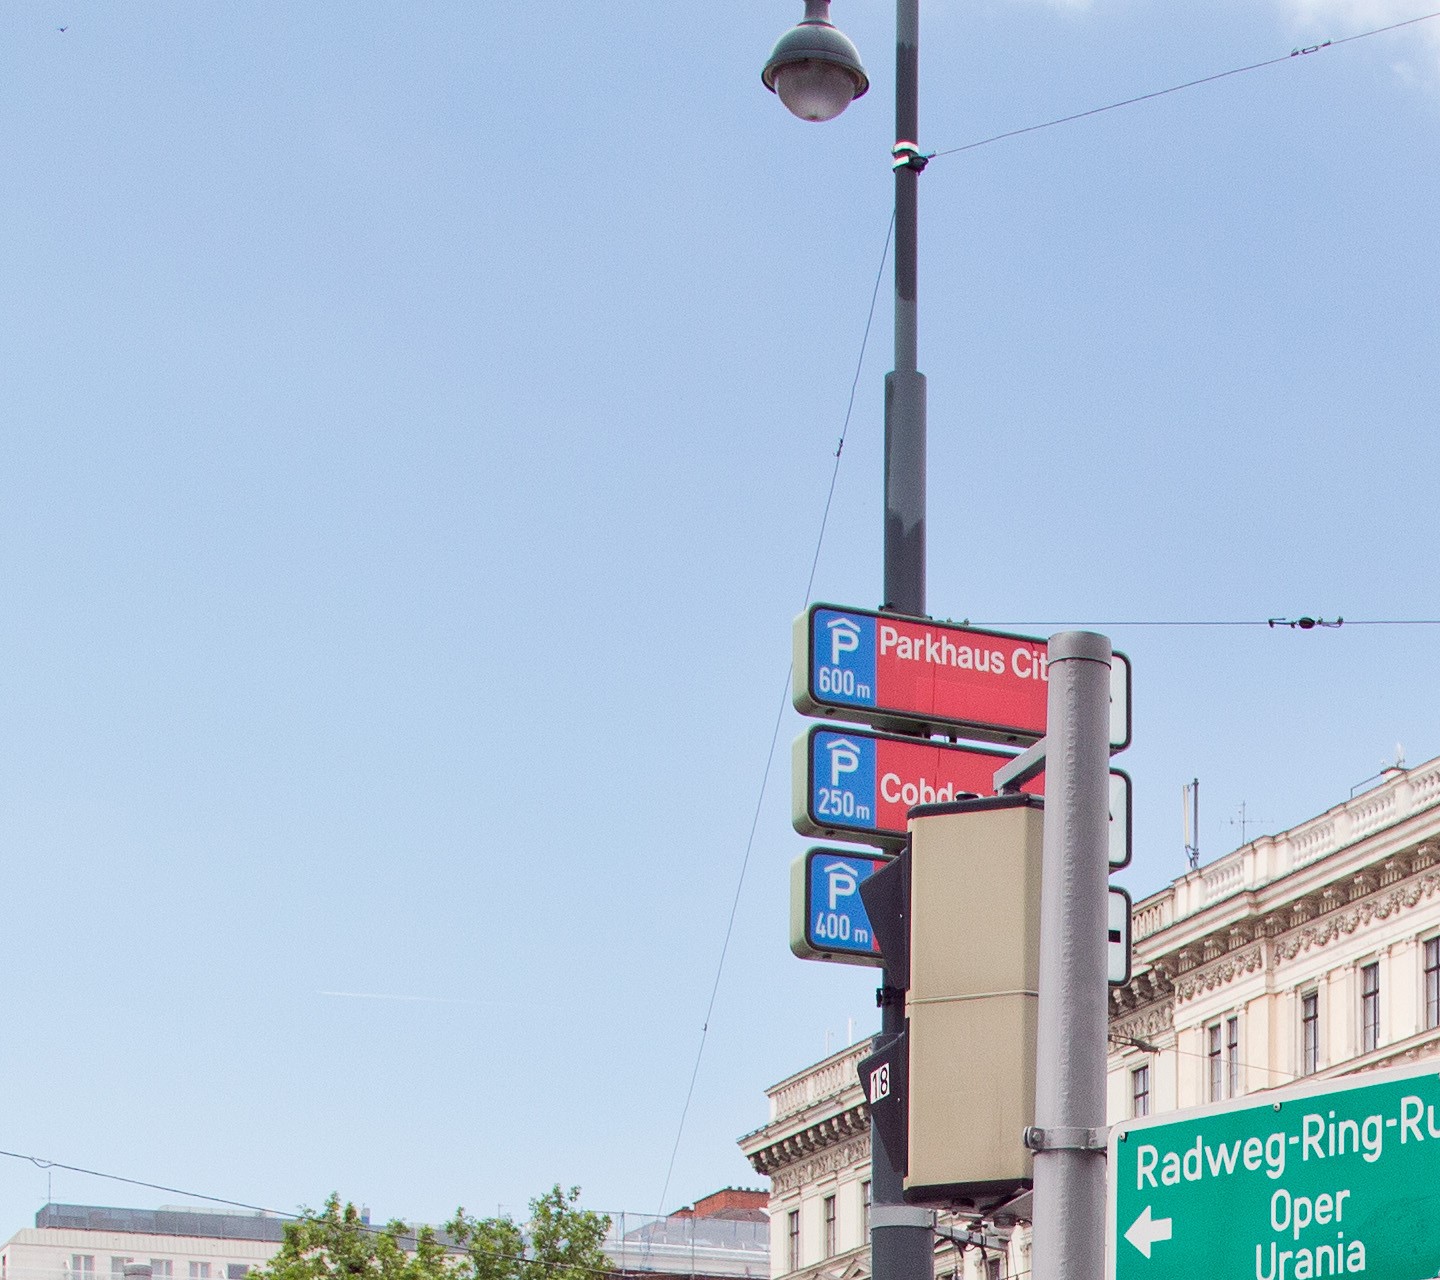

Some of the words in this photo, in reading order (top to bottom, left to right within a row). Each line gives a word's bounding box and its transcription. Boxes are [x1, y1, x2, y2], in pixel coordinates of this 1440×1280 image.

[879, 624, 1006, 675] Parkhaus
[1011, 648, 1049, 682] Cit
[873, 1067, 888, 1099] 18
[1270, 1189, 1351, 1240] Oper
